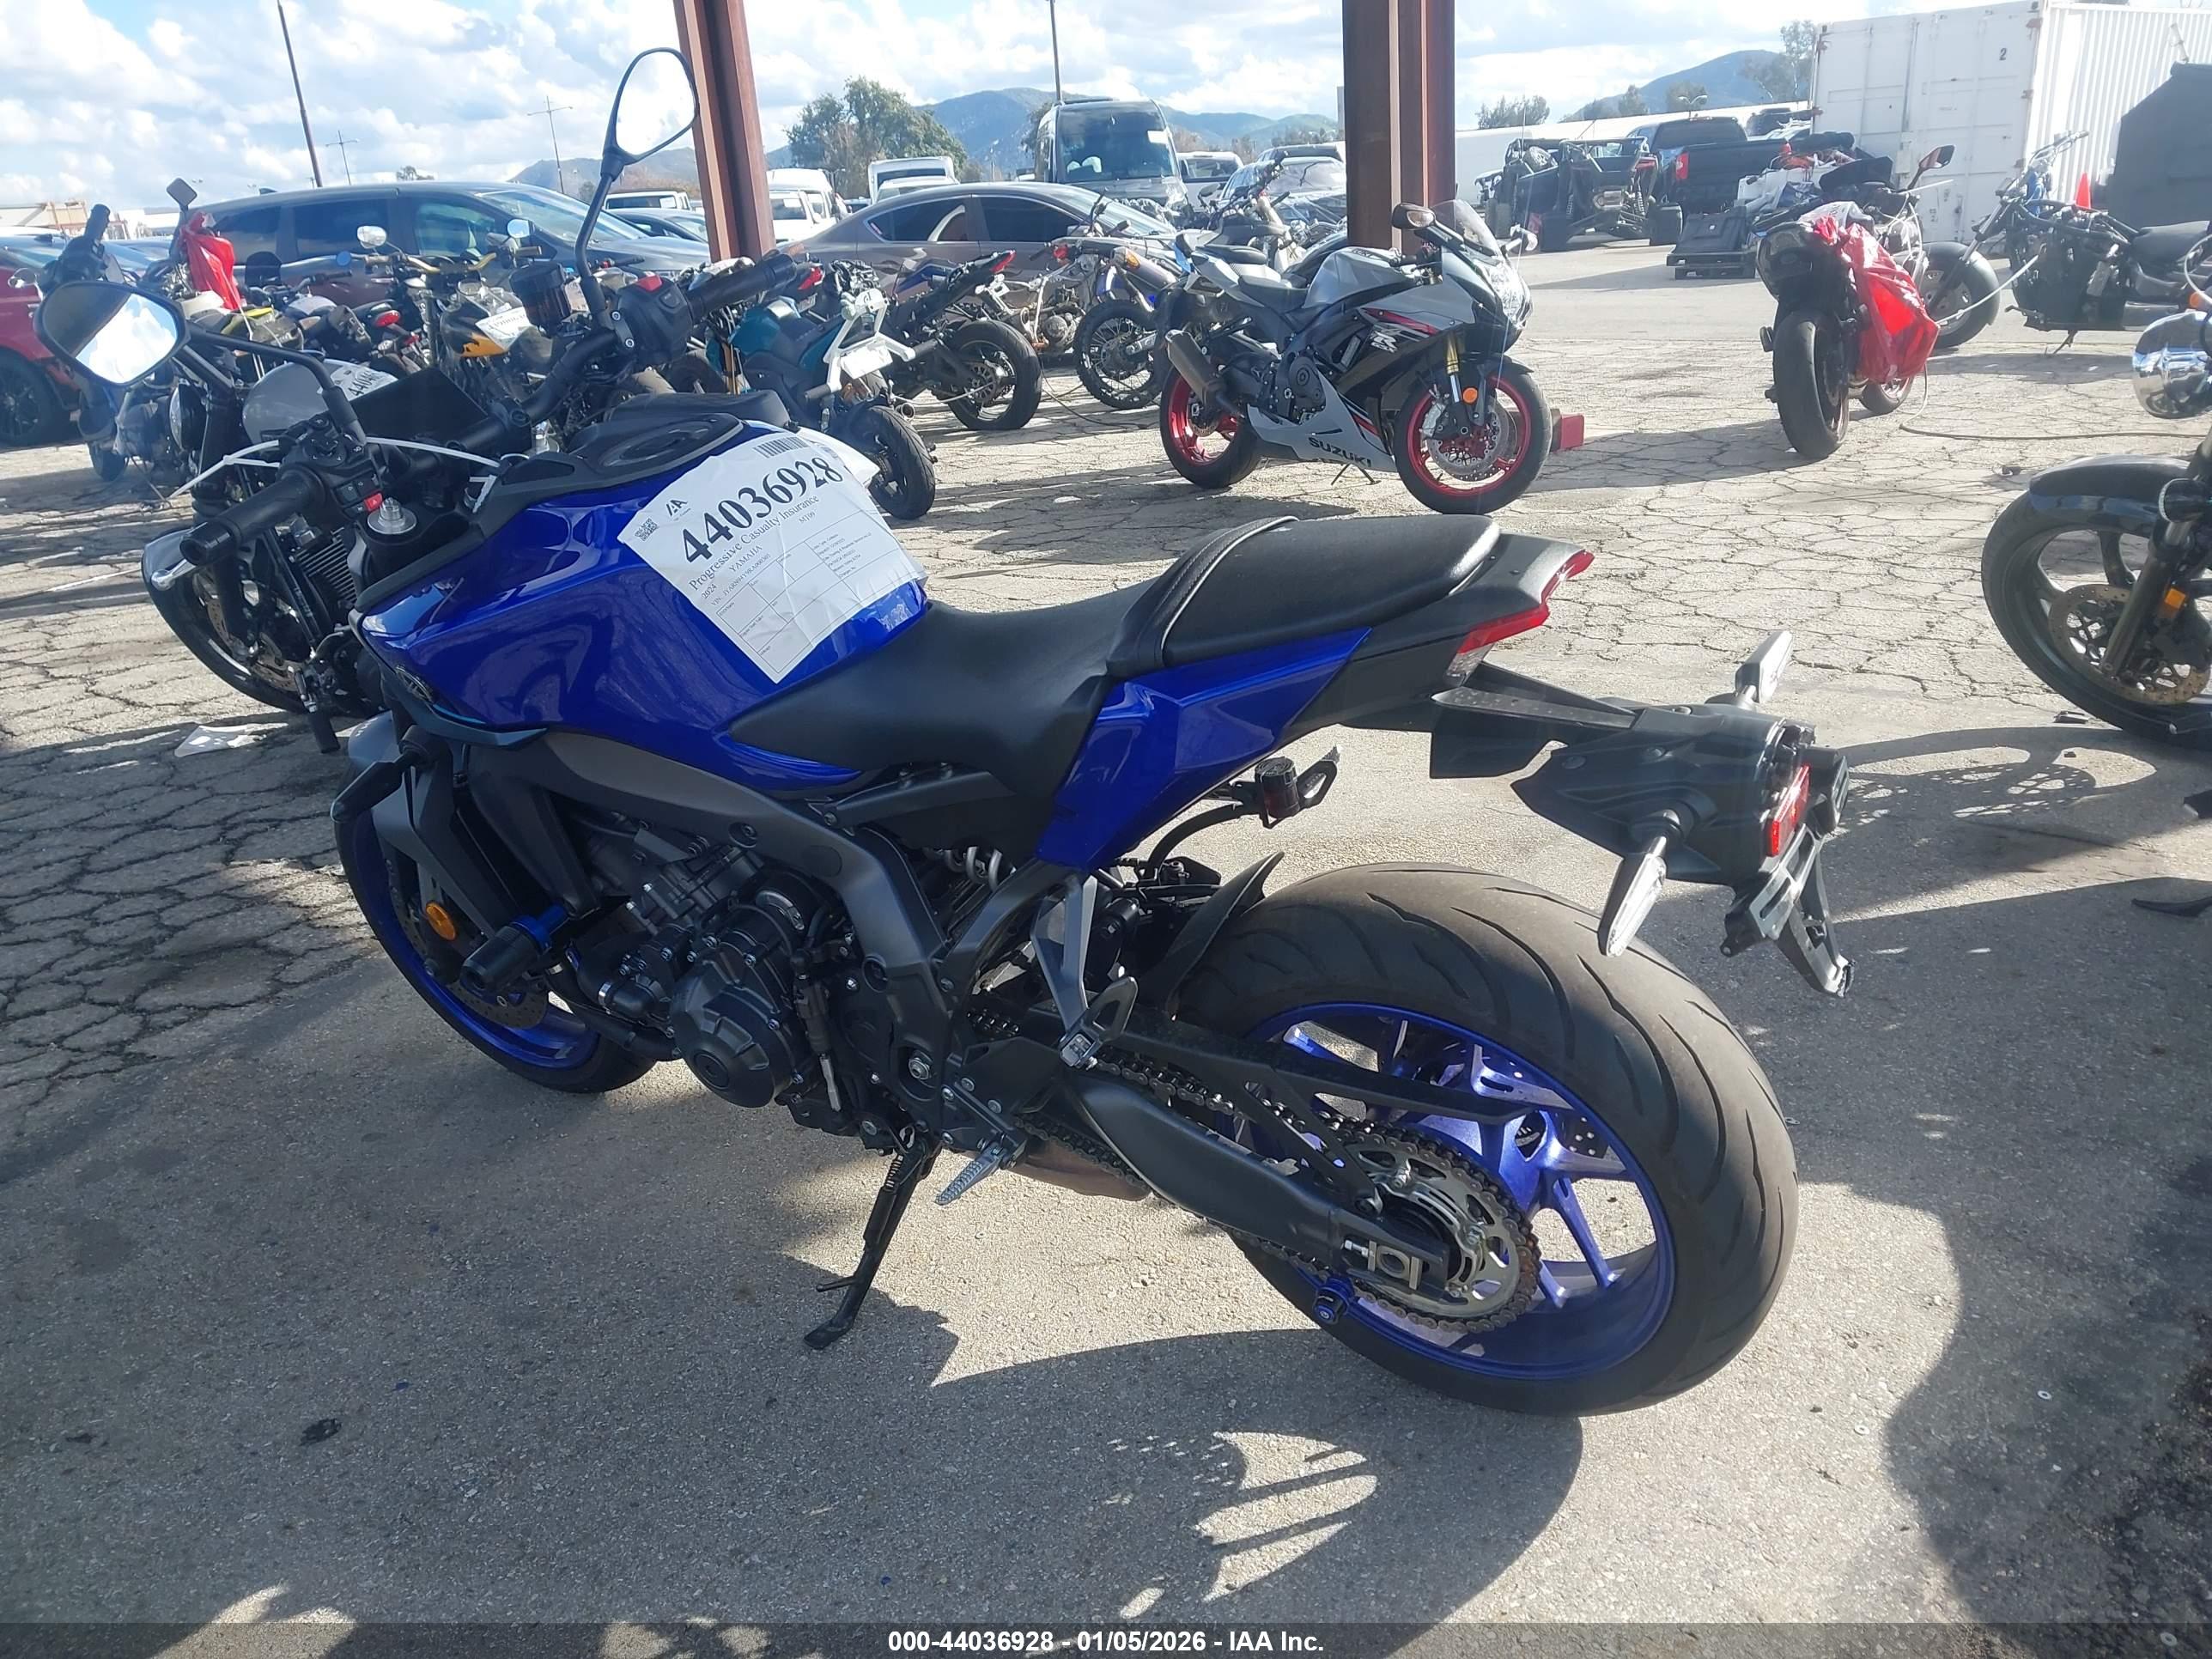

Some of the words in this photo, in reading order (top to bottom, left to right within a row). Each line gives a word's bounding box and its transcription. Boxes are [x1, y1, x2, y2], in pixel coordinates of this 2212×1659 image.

[1998, 47, 2007, 61] 2
[1308, 437, 1372, 468] SUZUKI
[679, 457, 843, 563] 44036928
[688, 544, 743, 592] Progressive
[740, 517, 781, 545] Casualty
[778, 495, 819, 520] Insurance
[701, 584, 718, 600] 2024
[728, 544, 763, 574] YAMAHA
